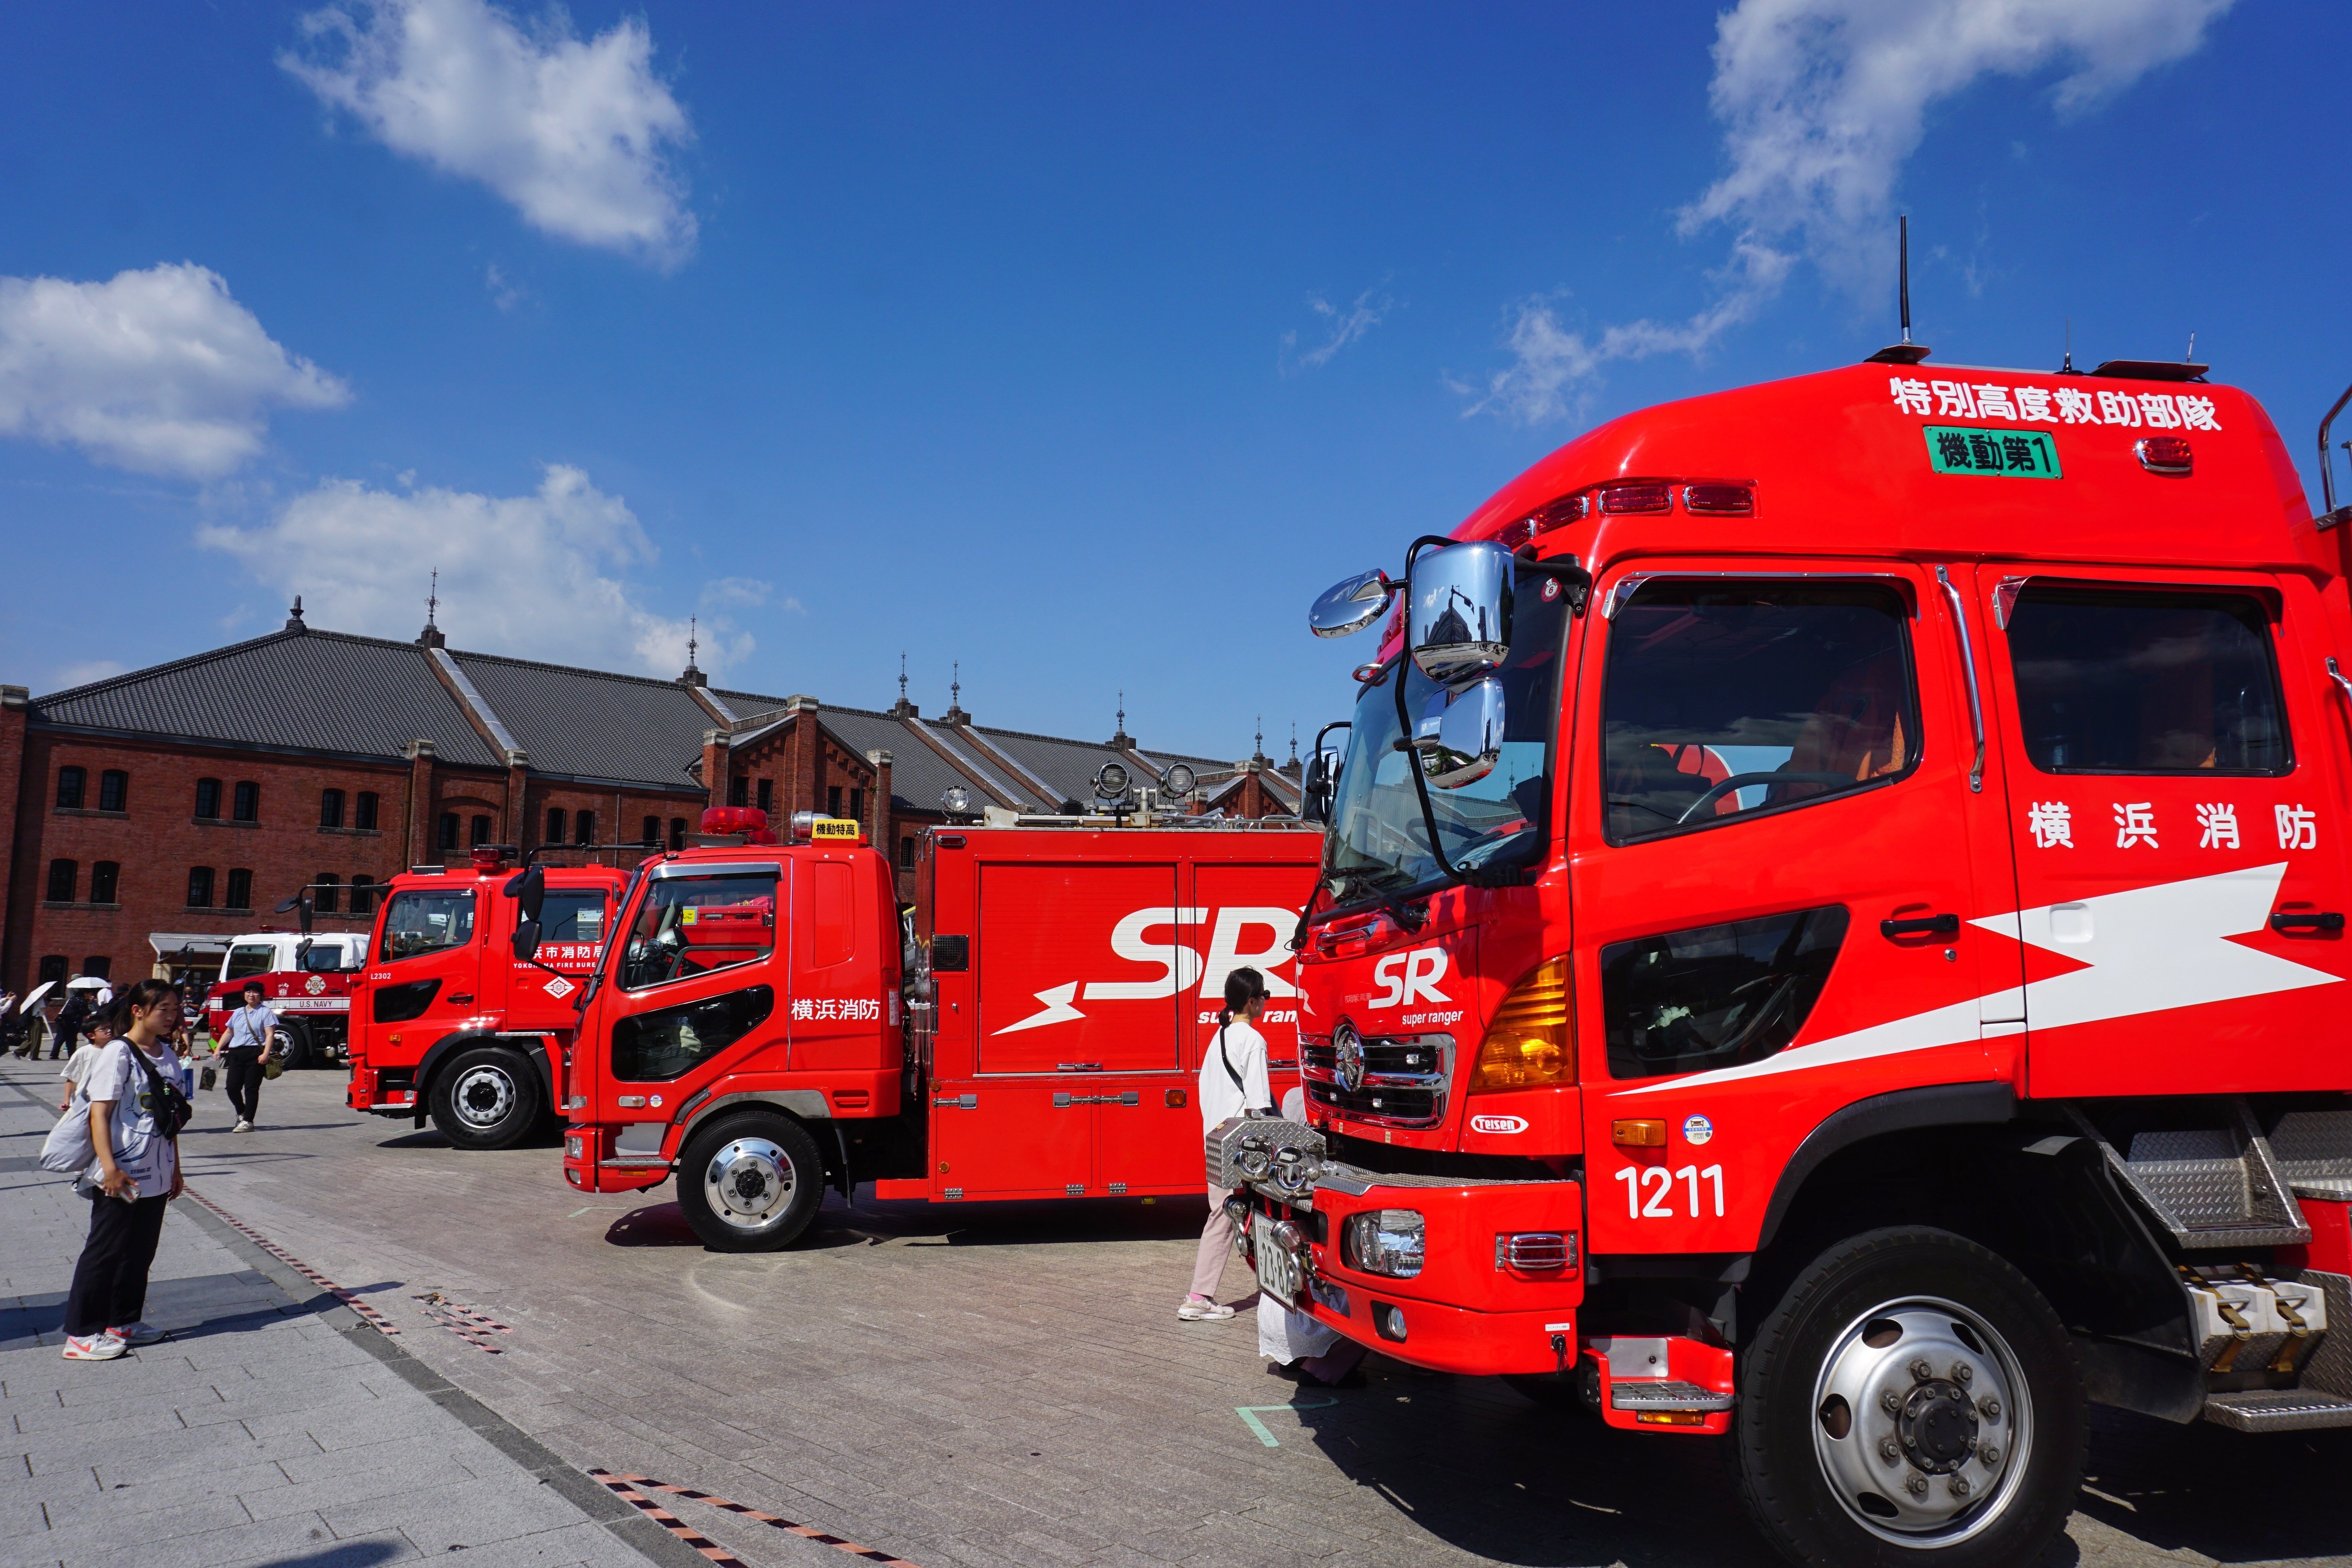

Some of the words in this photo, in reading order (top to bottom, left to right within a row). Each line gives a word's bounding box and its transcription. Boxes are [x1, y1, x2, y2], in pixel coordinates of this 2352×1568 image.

[1889, 376, 2222, 431] 特別高度救助部隊
[1937, 432, 2052, 473] 機動第1
[816, 822, 855, 836] 機動特高
[2028, 801, 2316, 849] 横浜消防
[532, 946, 604, 959] 浜市消防局
[1083, 907, 1299, 999] SR
[1368, 946, 1453, 1010] SR
[791, 998, 880, 1021] 横浜消防
[1402, 1012, 1428, 1027] super
[1428, 1010, 1463, 1026] ranger
[1477, 1119, 1515, 1131] Teisen
[1615, 1164, 1724, 1219] 1211
